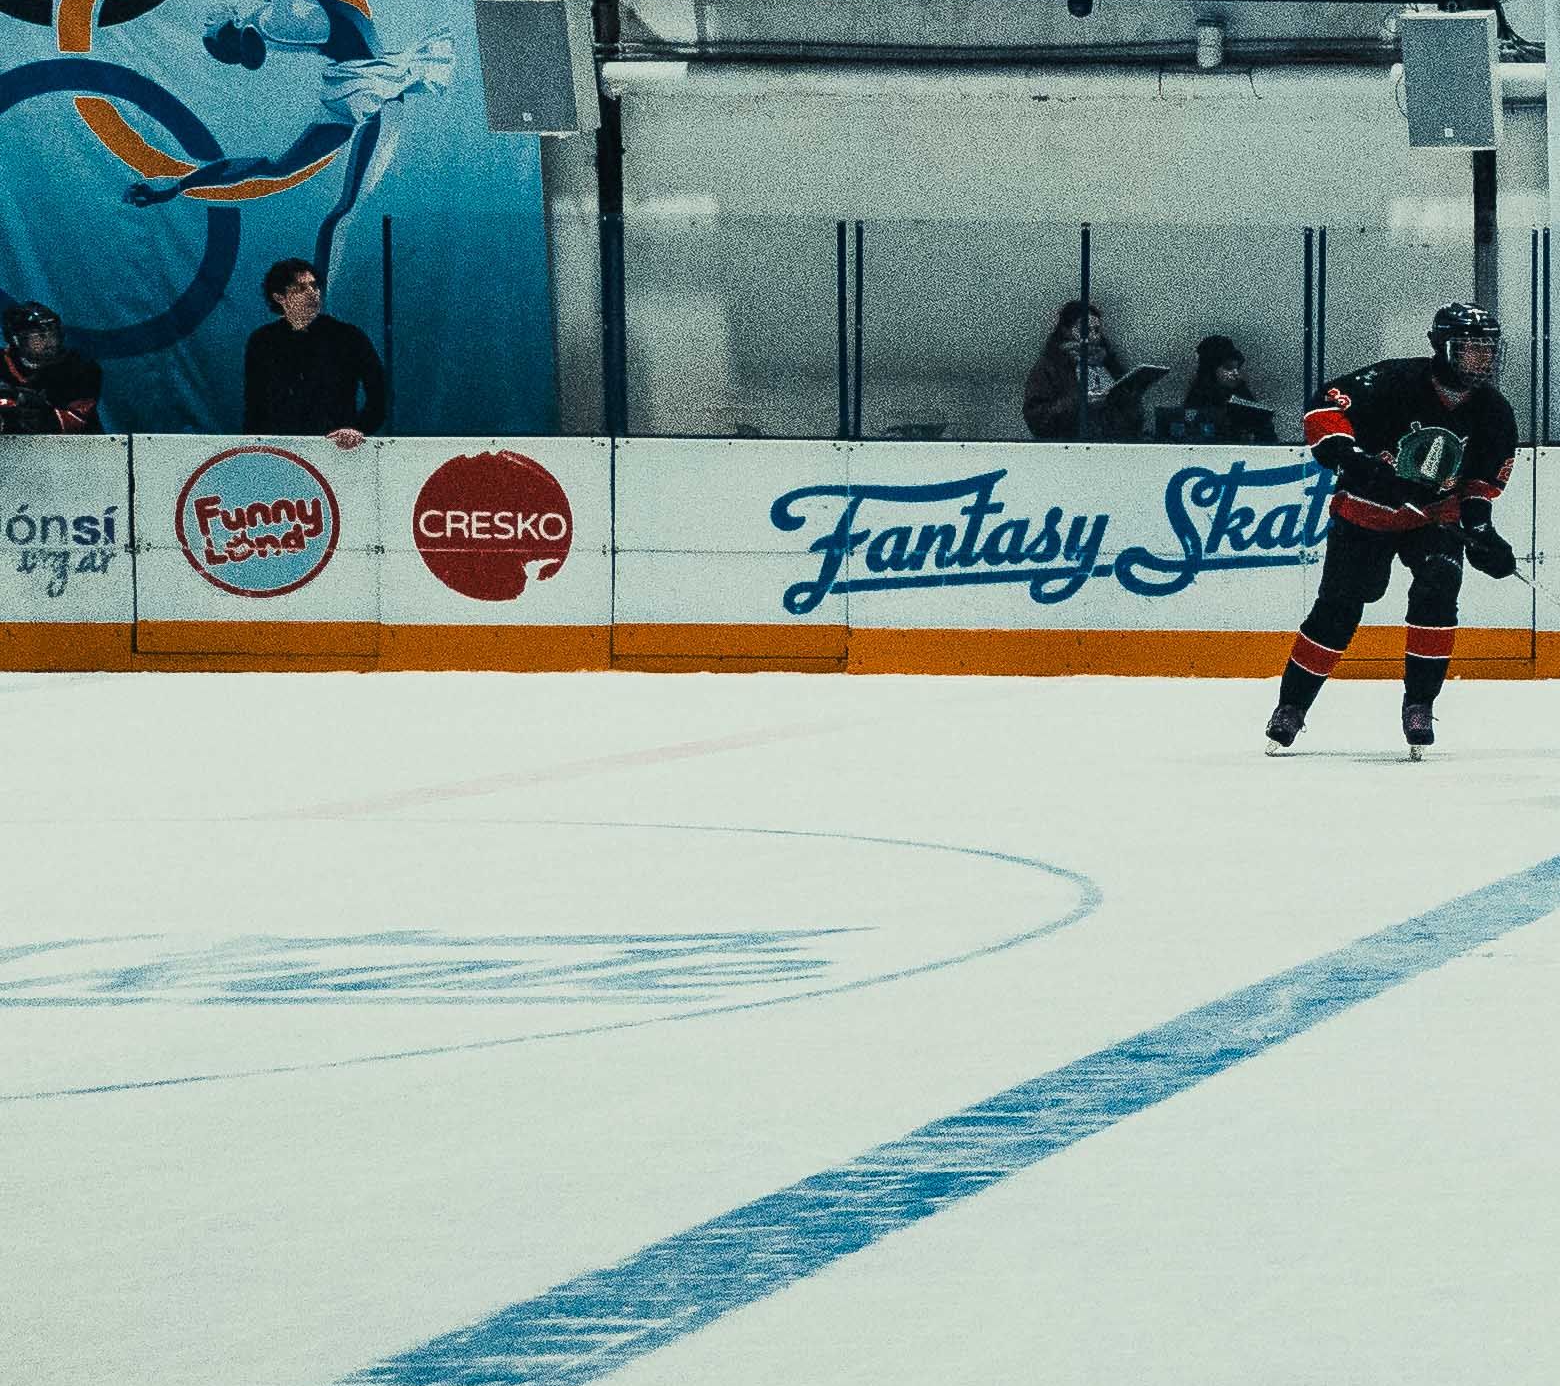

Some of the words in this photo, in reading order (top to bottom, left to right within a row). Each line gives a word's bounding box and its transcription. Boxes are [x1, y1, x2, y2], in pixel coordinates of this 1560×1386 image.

[193, 495, 324, 539] Funny
[418, 509, 569, 543] CRESKO
[769, 469, 1110, 616] Fantasy
[1114, 460, 1337, 598] Skat
